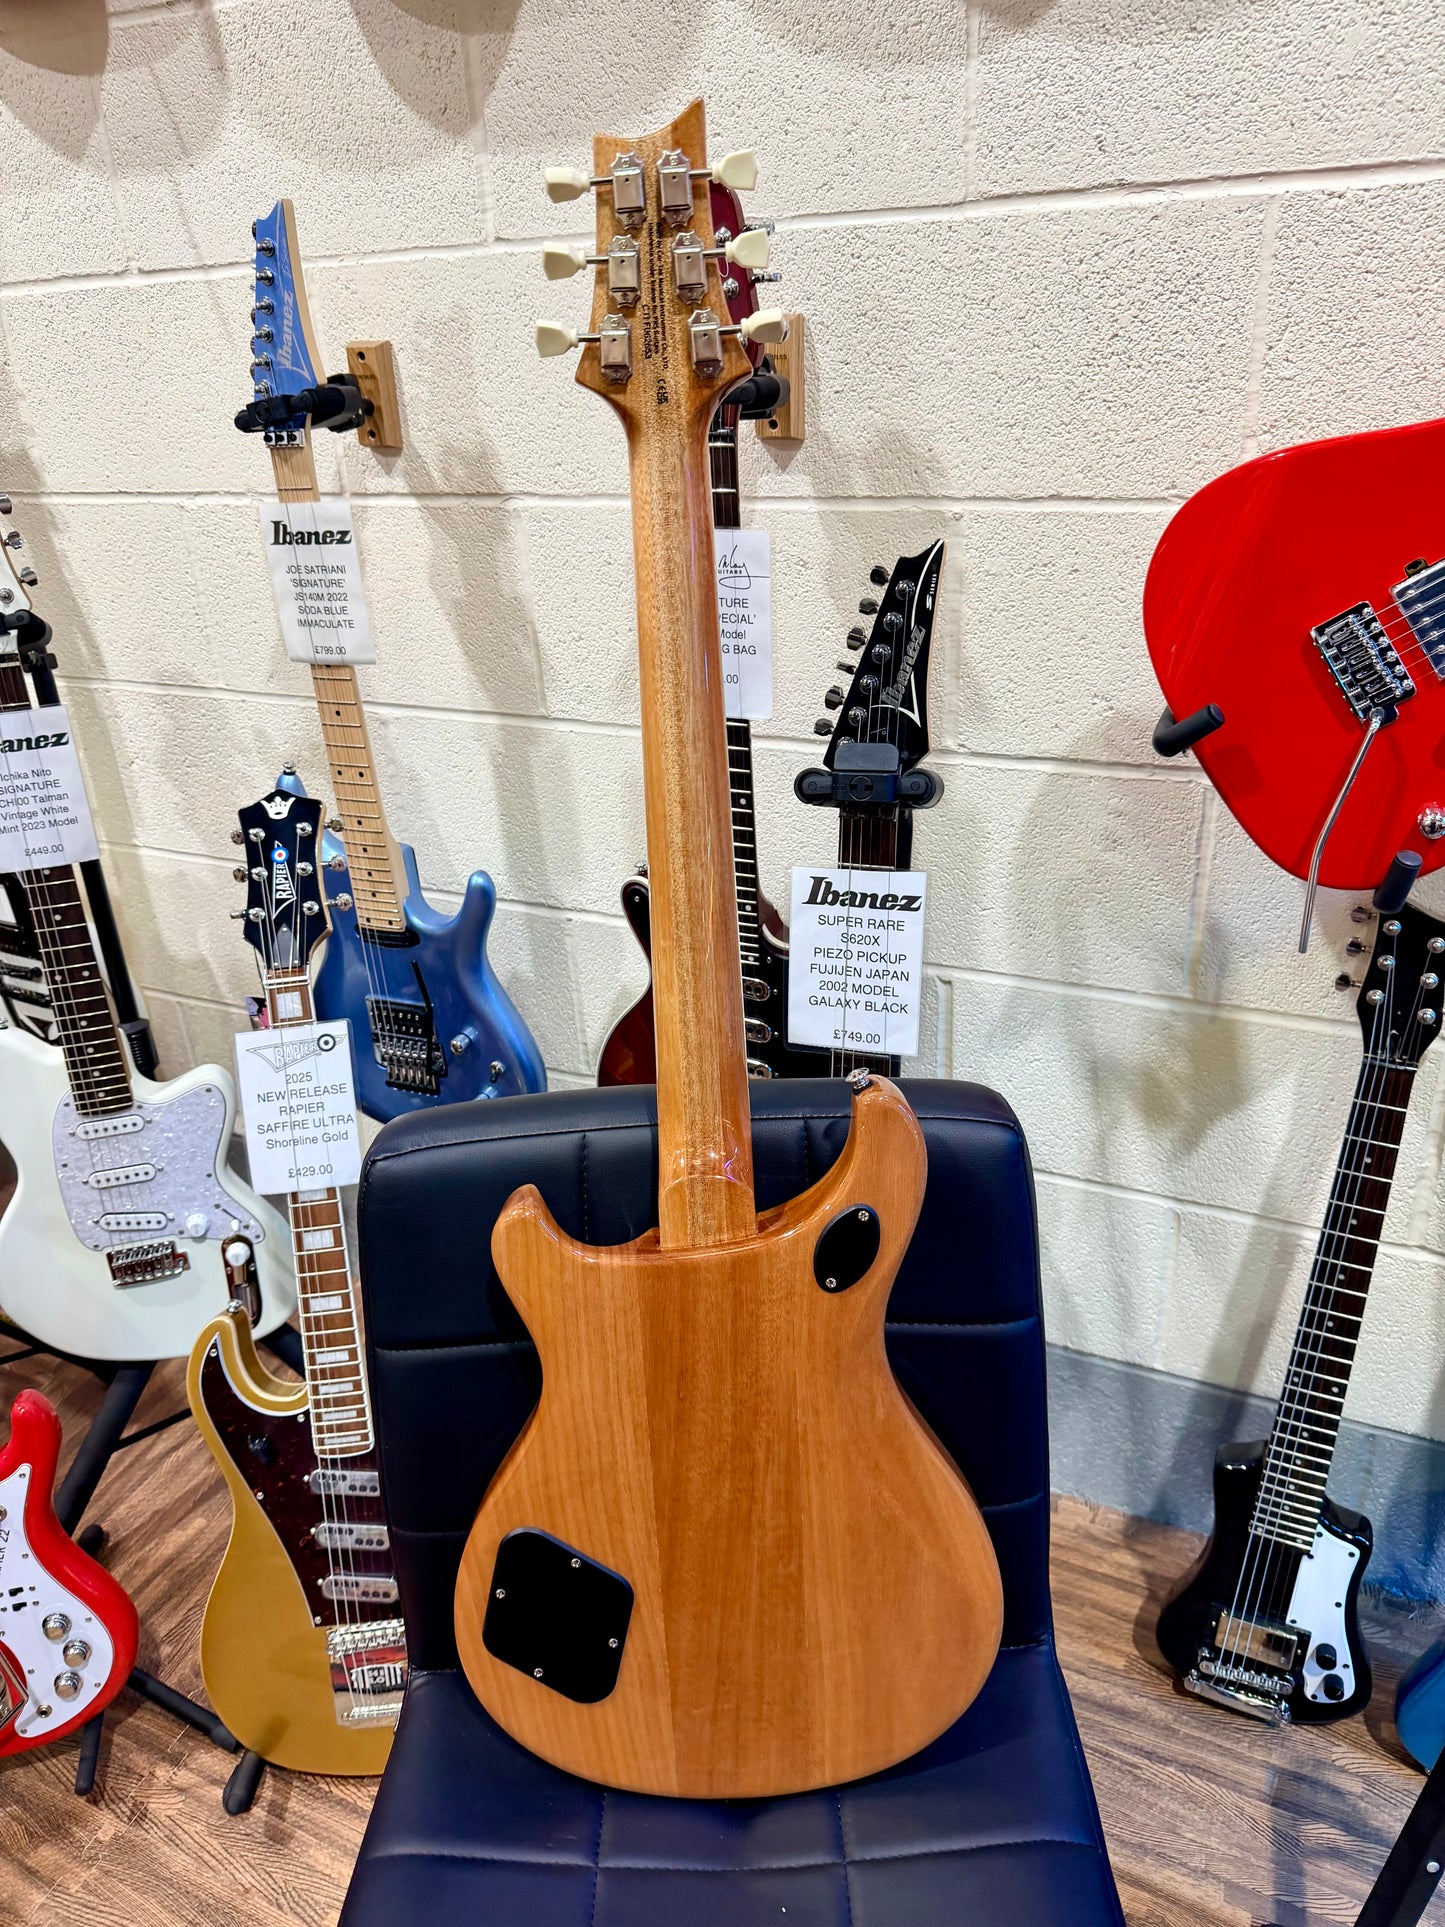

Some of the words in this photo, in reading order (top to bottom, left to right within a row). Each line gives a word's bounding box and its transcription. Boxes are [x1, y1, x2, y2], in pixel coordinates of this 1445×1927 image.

[276, 290, 293, 370] Ibanez
[270, 520, 352, 545] Ibanez
[286, 565, 303, 574] JOE
[304, 566, 346, 574] SATRIANI
[290, 578, 345, 588] 'SIGNATURE'
[294, 592, 324, 602] JS140M
[327, 592, 348, 602] 2022
[719, 598, 748, 608] TURE
[298, 606, 322, 615] SODA
[324, 606, 348, 616] BLUE
[719, 613, 756, 624] ECIAL'
[298, 619, 355, 628] IMMACULATE
[314, 646, 346, 655] £799.00
[733, 644, 756, 655] BAG
[880, 624, 926, 708] Ibanez
[724, 674, 738, 684] .00
[0, 732, 69, 754] anez
[31, 768, 52, 779] Nito
[31, 792, 70, 804] Talman
[1, 810, 38, 821] Vintage
[40, 805, 69, 816] White
[22, 820, 46, 832] 2023
[48, 816, 78, 828] Model
[24, 844, 64, 857] £449.00
[276, 863, 294, 899] RAPIER
[802, 876, 922, 912] Ibanez
[818, 914, 863, 929] SUPER
[867, 919, 905, 932] RARE
[840, 932, 880, 946] S620X
[814, 947, 854, 960] PIEZO
[857, 950, 906, 964] PICKUP
[810, 964, 862, 978] FUJIJEN
[866, 968, 910, 982] JAPAN
[818, 980, 848, 992] 2002
[852, 984, 900, 998] MODEL
[808, 995, 861, 1010] GALAXY
[864, 1001, 908, 1014] BLACK
[833, 1029, 880, 1044] £749.00
[274, 1042, 318, 1068] RAPIER
[286, 1072, 312, 1084] 2025
[257, 1090, 286, 1103] NEW
[290, 1083, 348, 1099] RELEASE
[280, 1102, 326, 1116] RAPIER
[257, 1119, 310, 1134] SAFFIRE
[313, 1114, 354, 1128] ULTRA
[266, 1135, 318, 1149] Shoreline
[322, 1130, 348, 1142] Gold
[288, 1164, 334, 1178] £429.00
